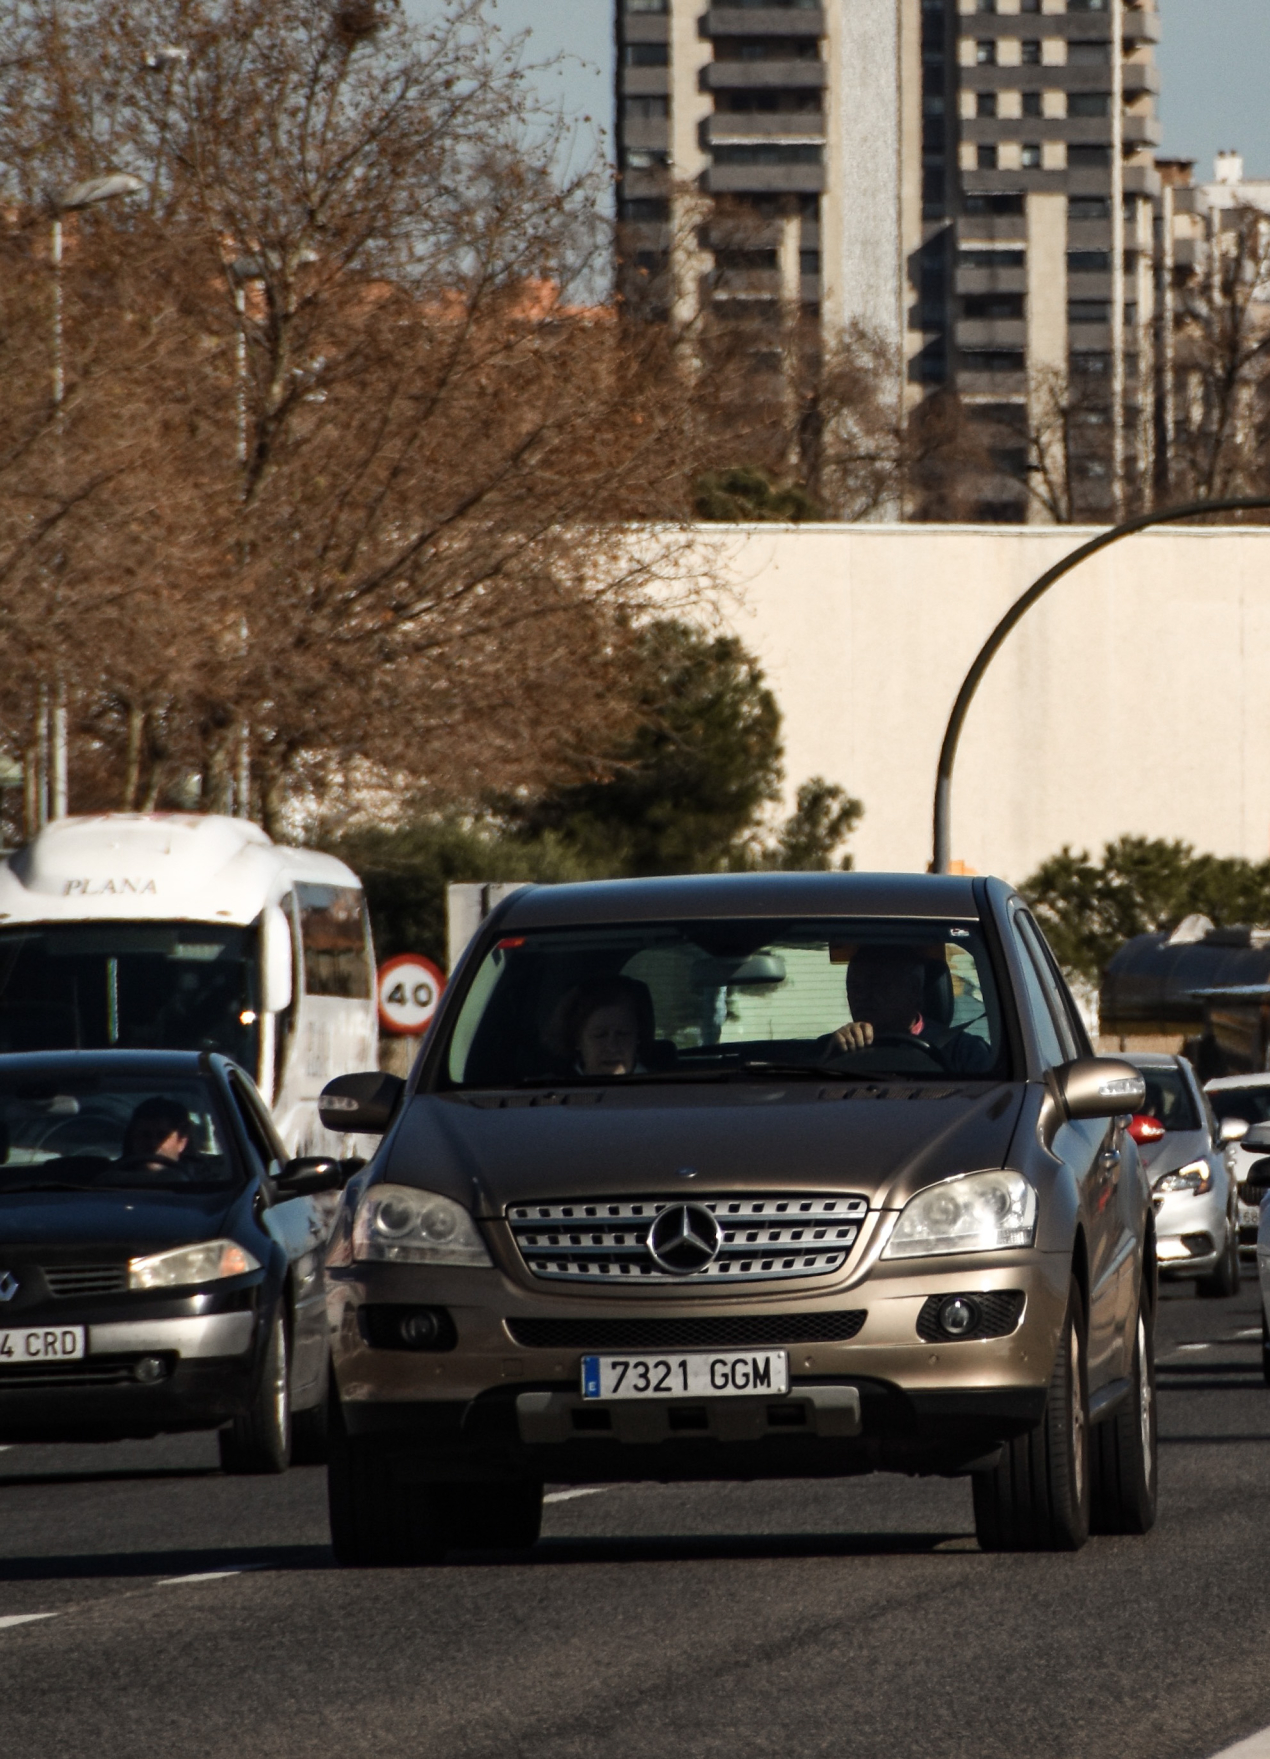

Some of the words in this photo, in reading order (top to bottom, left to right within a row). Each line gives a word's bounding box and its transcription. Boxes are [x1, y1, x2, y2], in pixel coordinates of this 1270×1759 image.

[62, 878, 157, 896] PLANA
[388, 983, 433, 1007] 40
[25, 1331, 76, 1356] CRD
[611, 1360, 688, 1393] 7321
[710, 1357, 771, 1390] GGM
